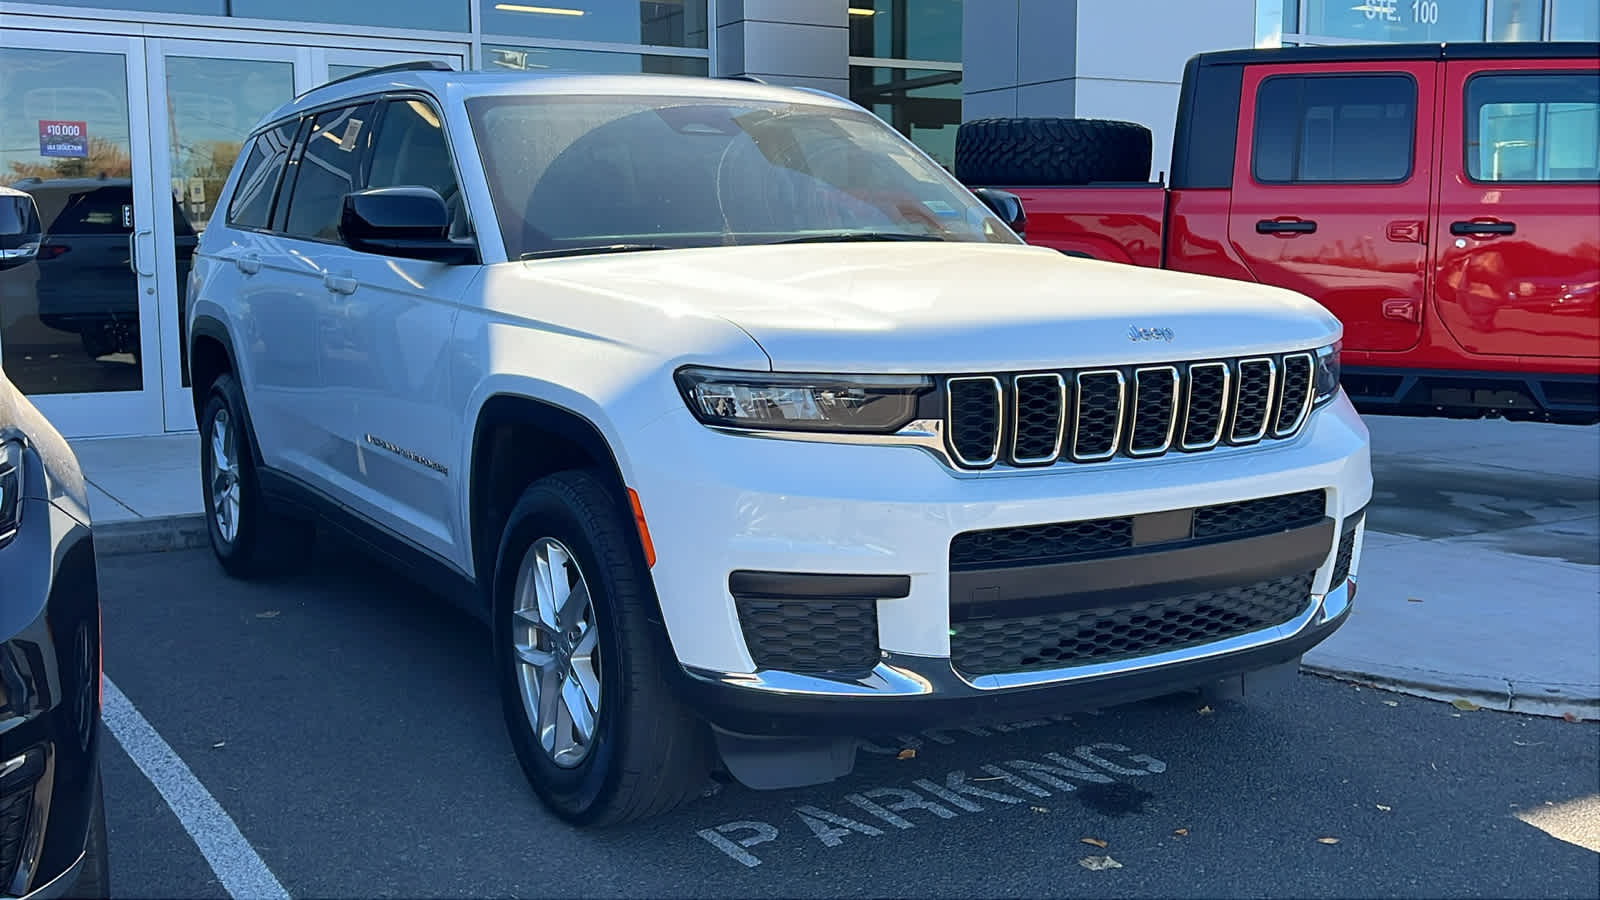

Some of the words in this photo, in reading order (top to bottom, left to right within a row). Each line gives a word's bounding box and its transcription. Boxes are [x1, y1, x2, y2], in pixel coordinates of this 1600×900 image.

[1364, 0, 1401, 21] STE.
[1412, 0, 1438, 24] 100
[1128, 323, 1175, 344] Jeep
[697, 742, 1167, 868] PARKING
